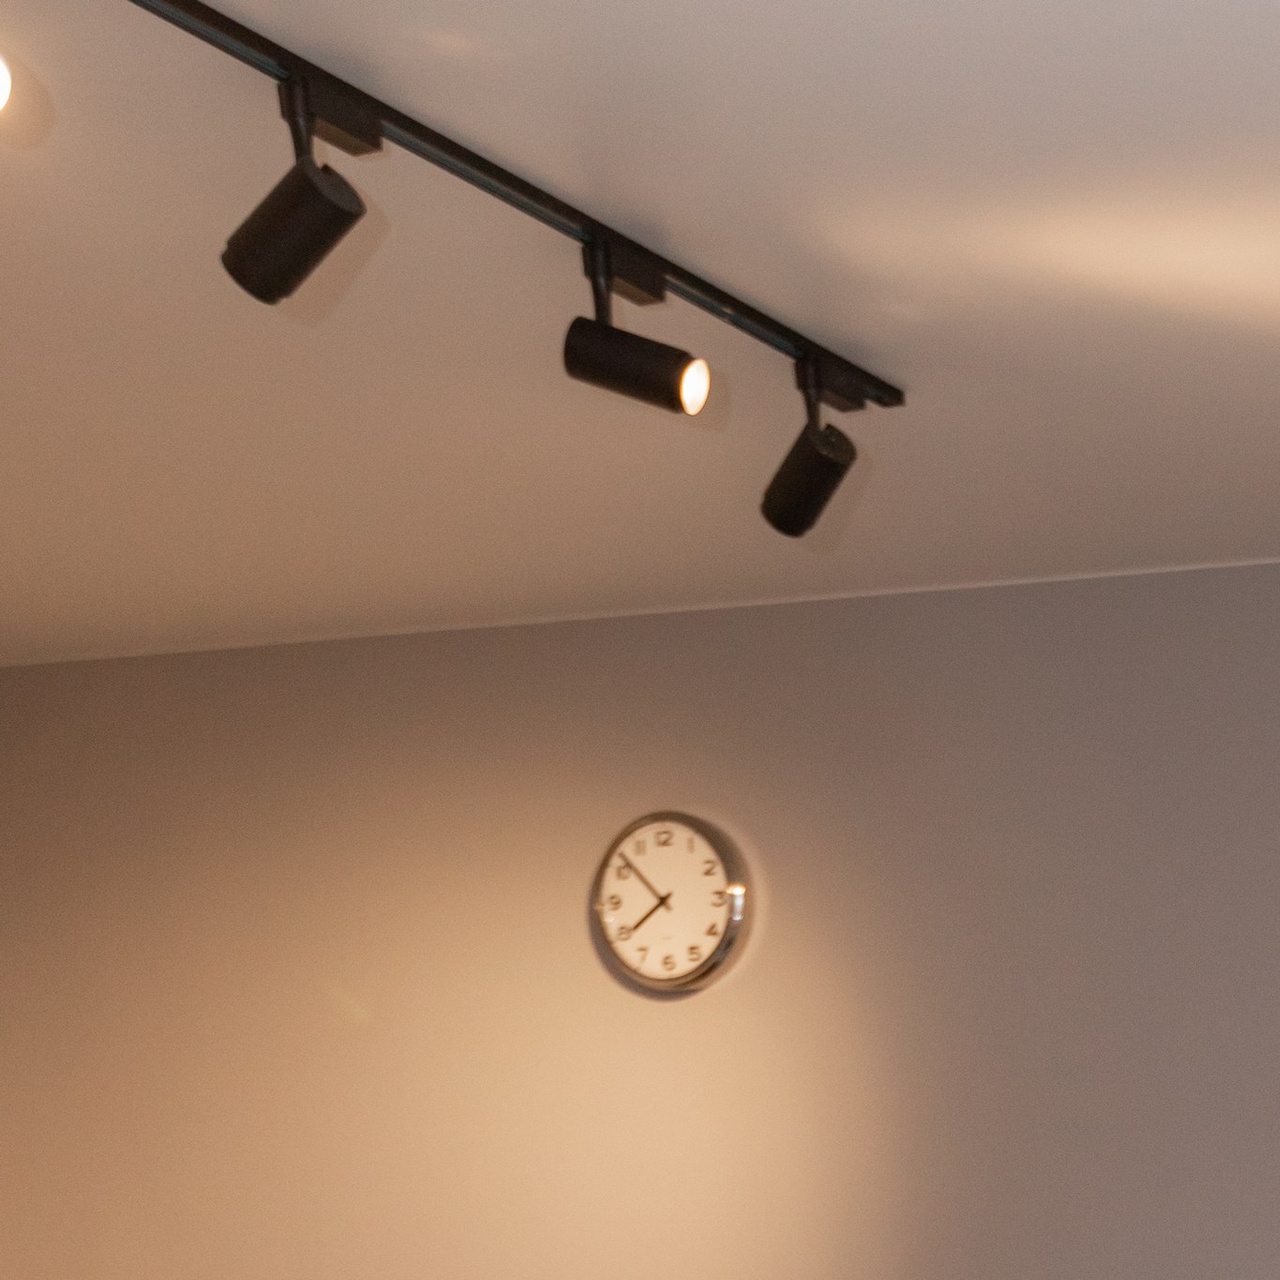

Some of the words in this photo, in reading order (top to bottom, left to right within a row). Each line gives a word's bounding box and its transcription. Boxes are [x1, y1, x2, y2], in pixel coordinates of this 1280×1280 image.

[655, 830, 673, 846] 12
[703, 860, 716, 875] 2
[608, 895, 621, 910] 9
[711, 890, 727, 907] 3
[705, 923, 718, 935] 4
[637, 946, 648, 962] 7
[687, 945, 701, 961] 5
[661, 954, 675, 970] 6
